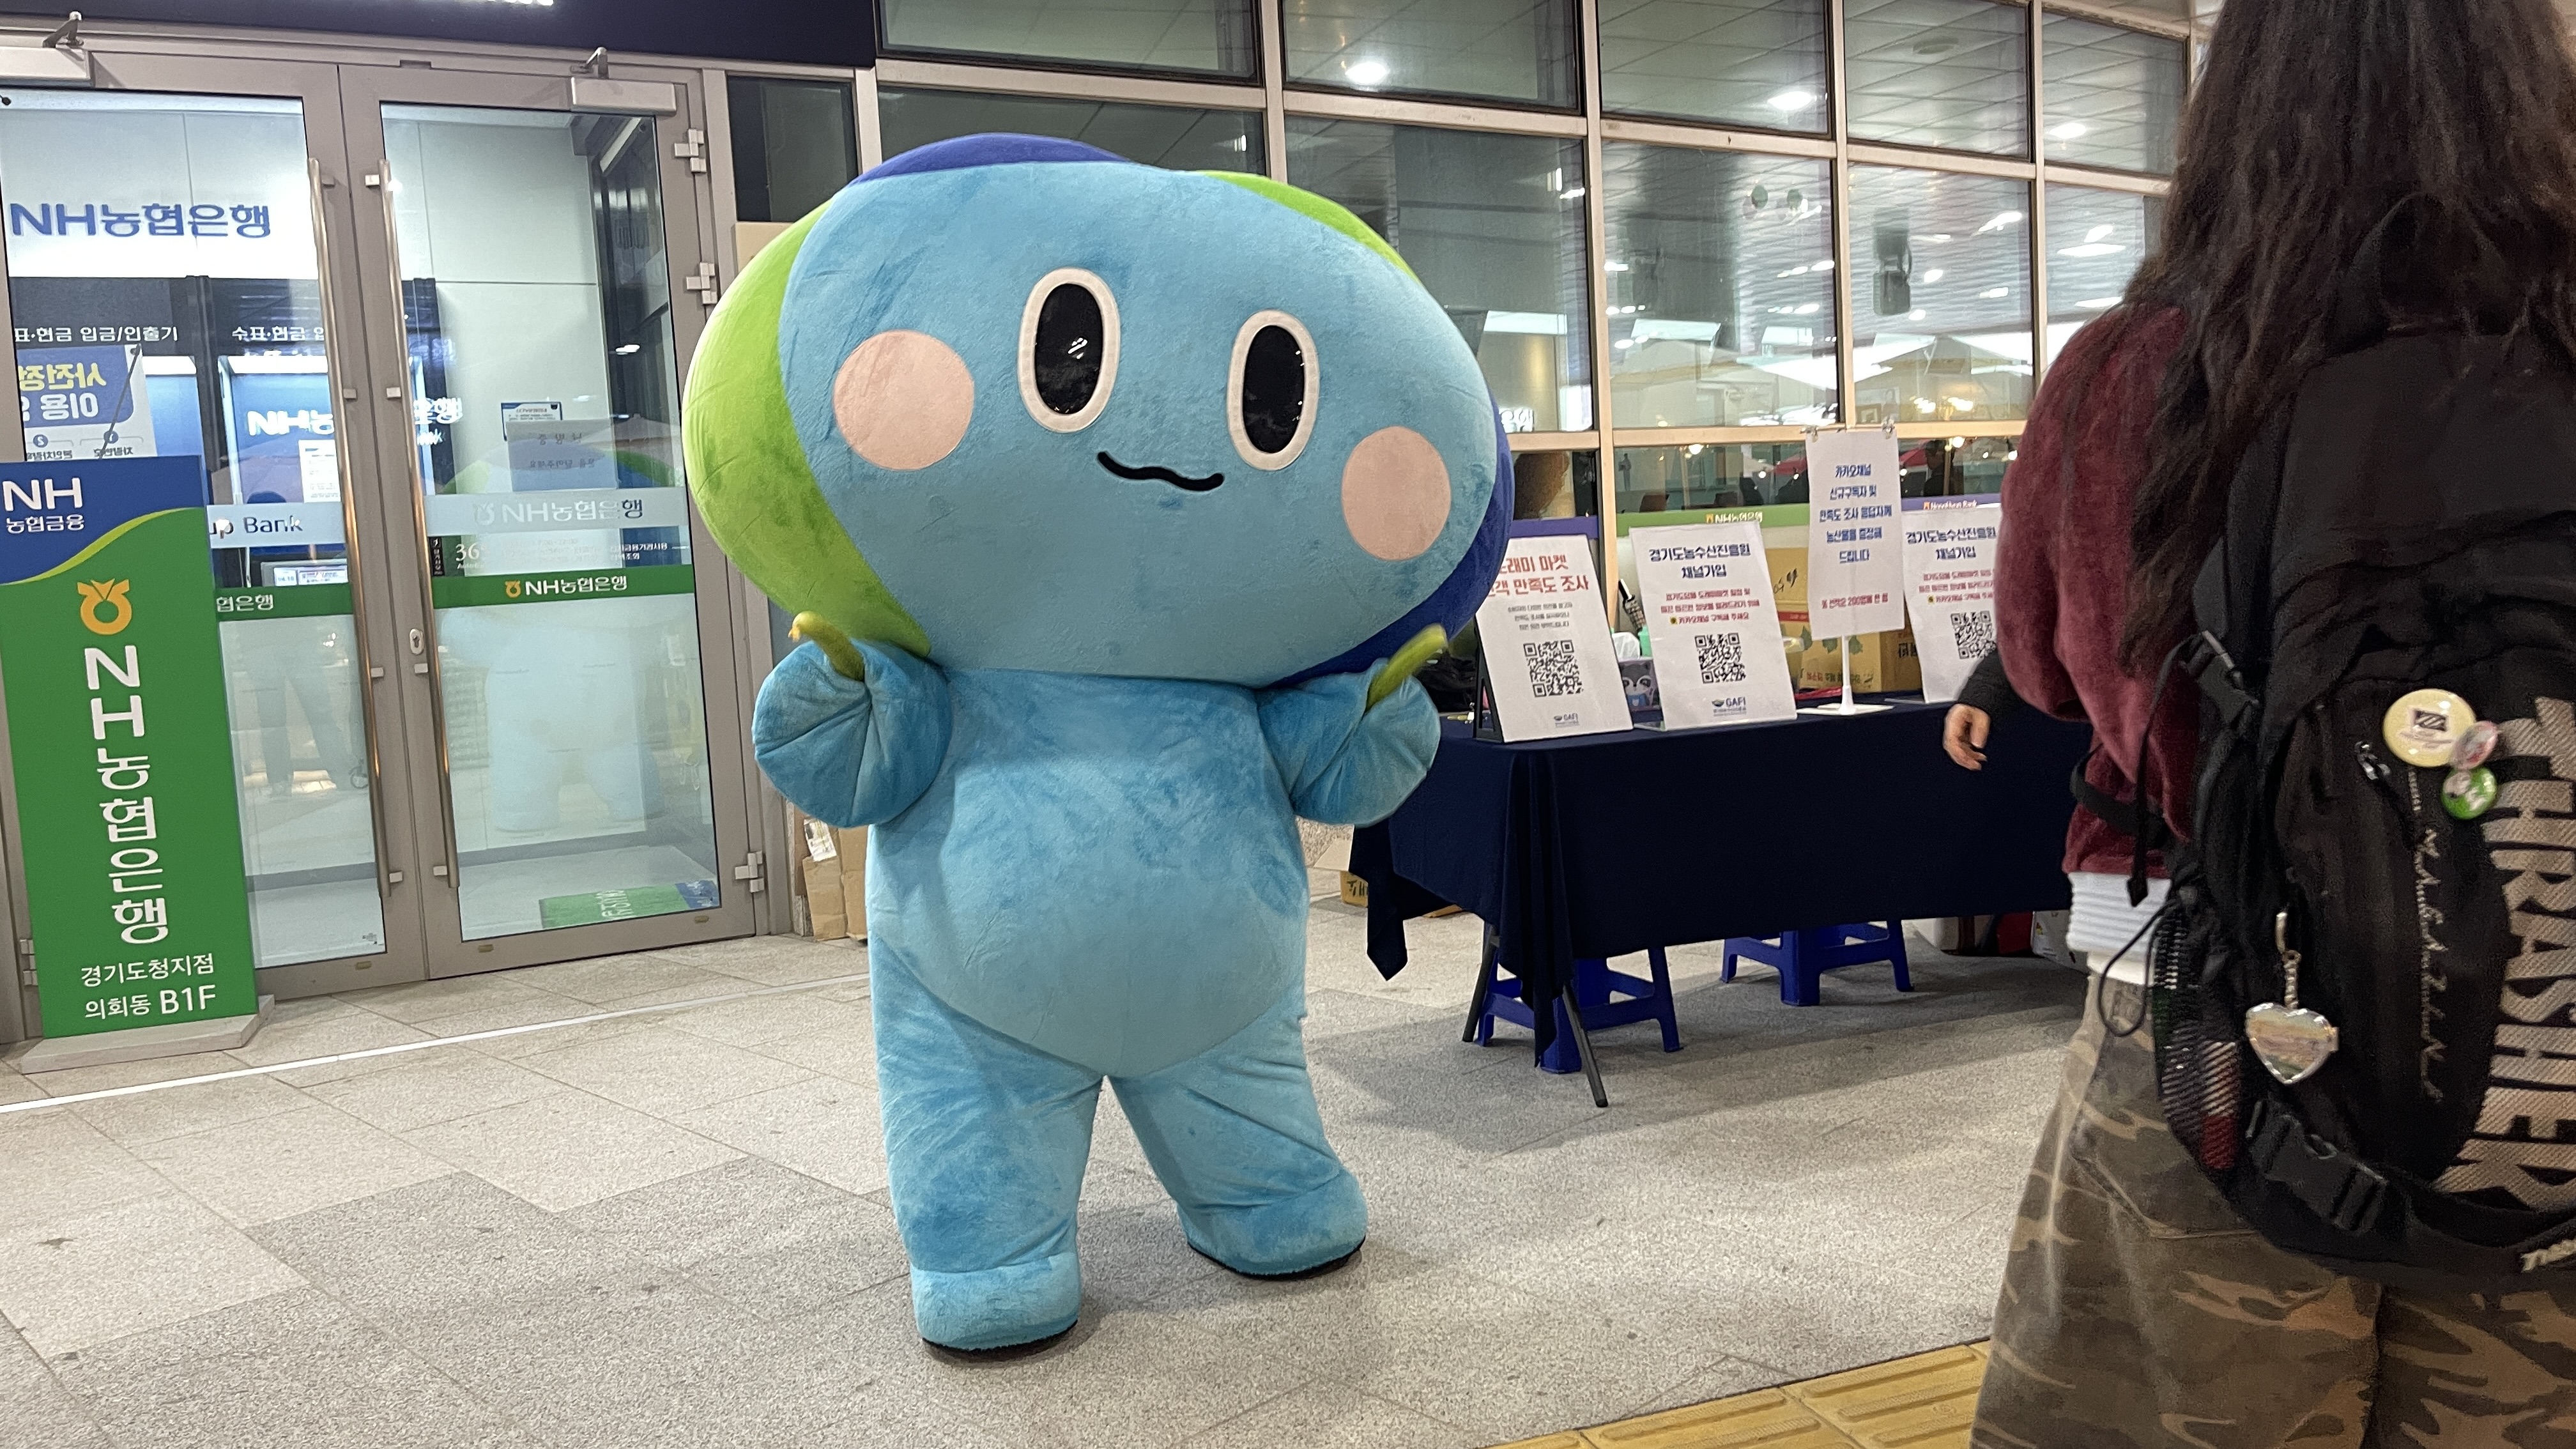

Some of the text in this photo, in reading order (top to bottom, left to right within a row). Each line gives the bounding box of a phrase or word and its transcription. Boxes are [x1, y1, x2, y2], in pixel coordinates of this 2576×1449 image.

[10, 203, 271, 238] NH농협은행
[2, 477, 84, 511] NH
[502, 498, 643, 524] NH농협은행
[6, 514, 85, 533] 농협금융
[243, 515, 303, 534] Bank
[1538, 555, 1569, 571] 마켓
[1649, 543, 1751, 562] 경기도농수산진흥원
[1682, 564, 1727, 579] 채널가입
[525, 575, 628, 596] NH농협은행
[1513, 576, 1558, 595] 만족도
[1560, 575, 1590, 592] 조사
[84, 645, 169, 945] NH농협은행
[2433, 695, 2576, 1212] THRASHER
[80, 953, 215, 988] 경기도청지점
[84, 984, 217, 1020] 의회동 B1F
